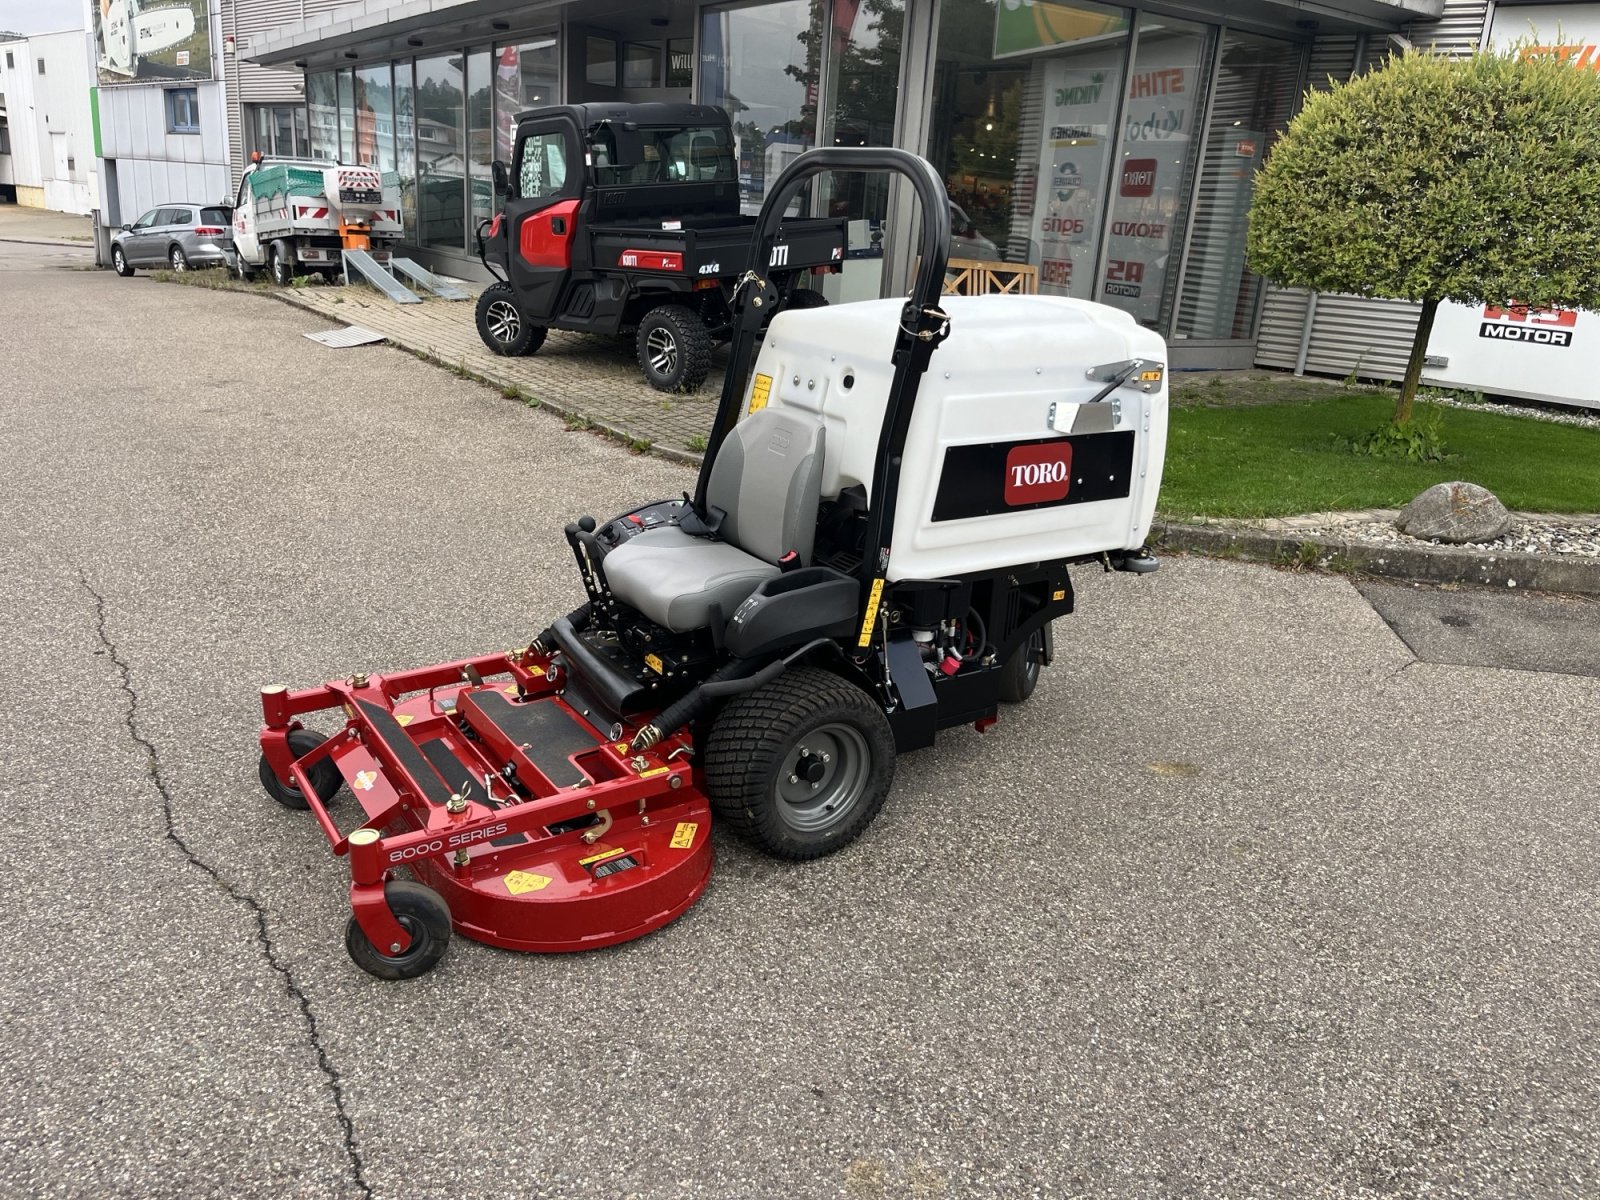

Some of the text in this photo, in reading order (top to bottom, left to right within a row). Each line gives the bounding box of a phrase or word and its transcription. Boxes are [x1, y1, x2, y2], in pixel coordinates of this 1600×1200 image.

[769, 245, 789, 267] OTI
[1484, 325, 1567, 345] MOTOR
[1011, 461, 1067, 487] TORO
[390, 823, 507, 862] 8000 SERIES
